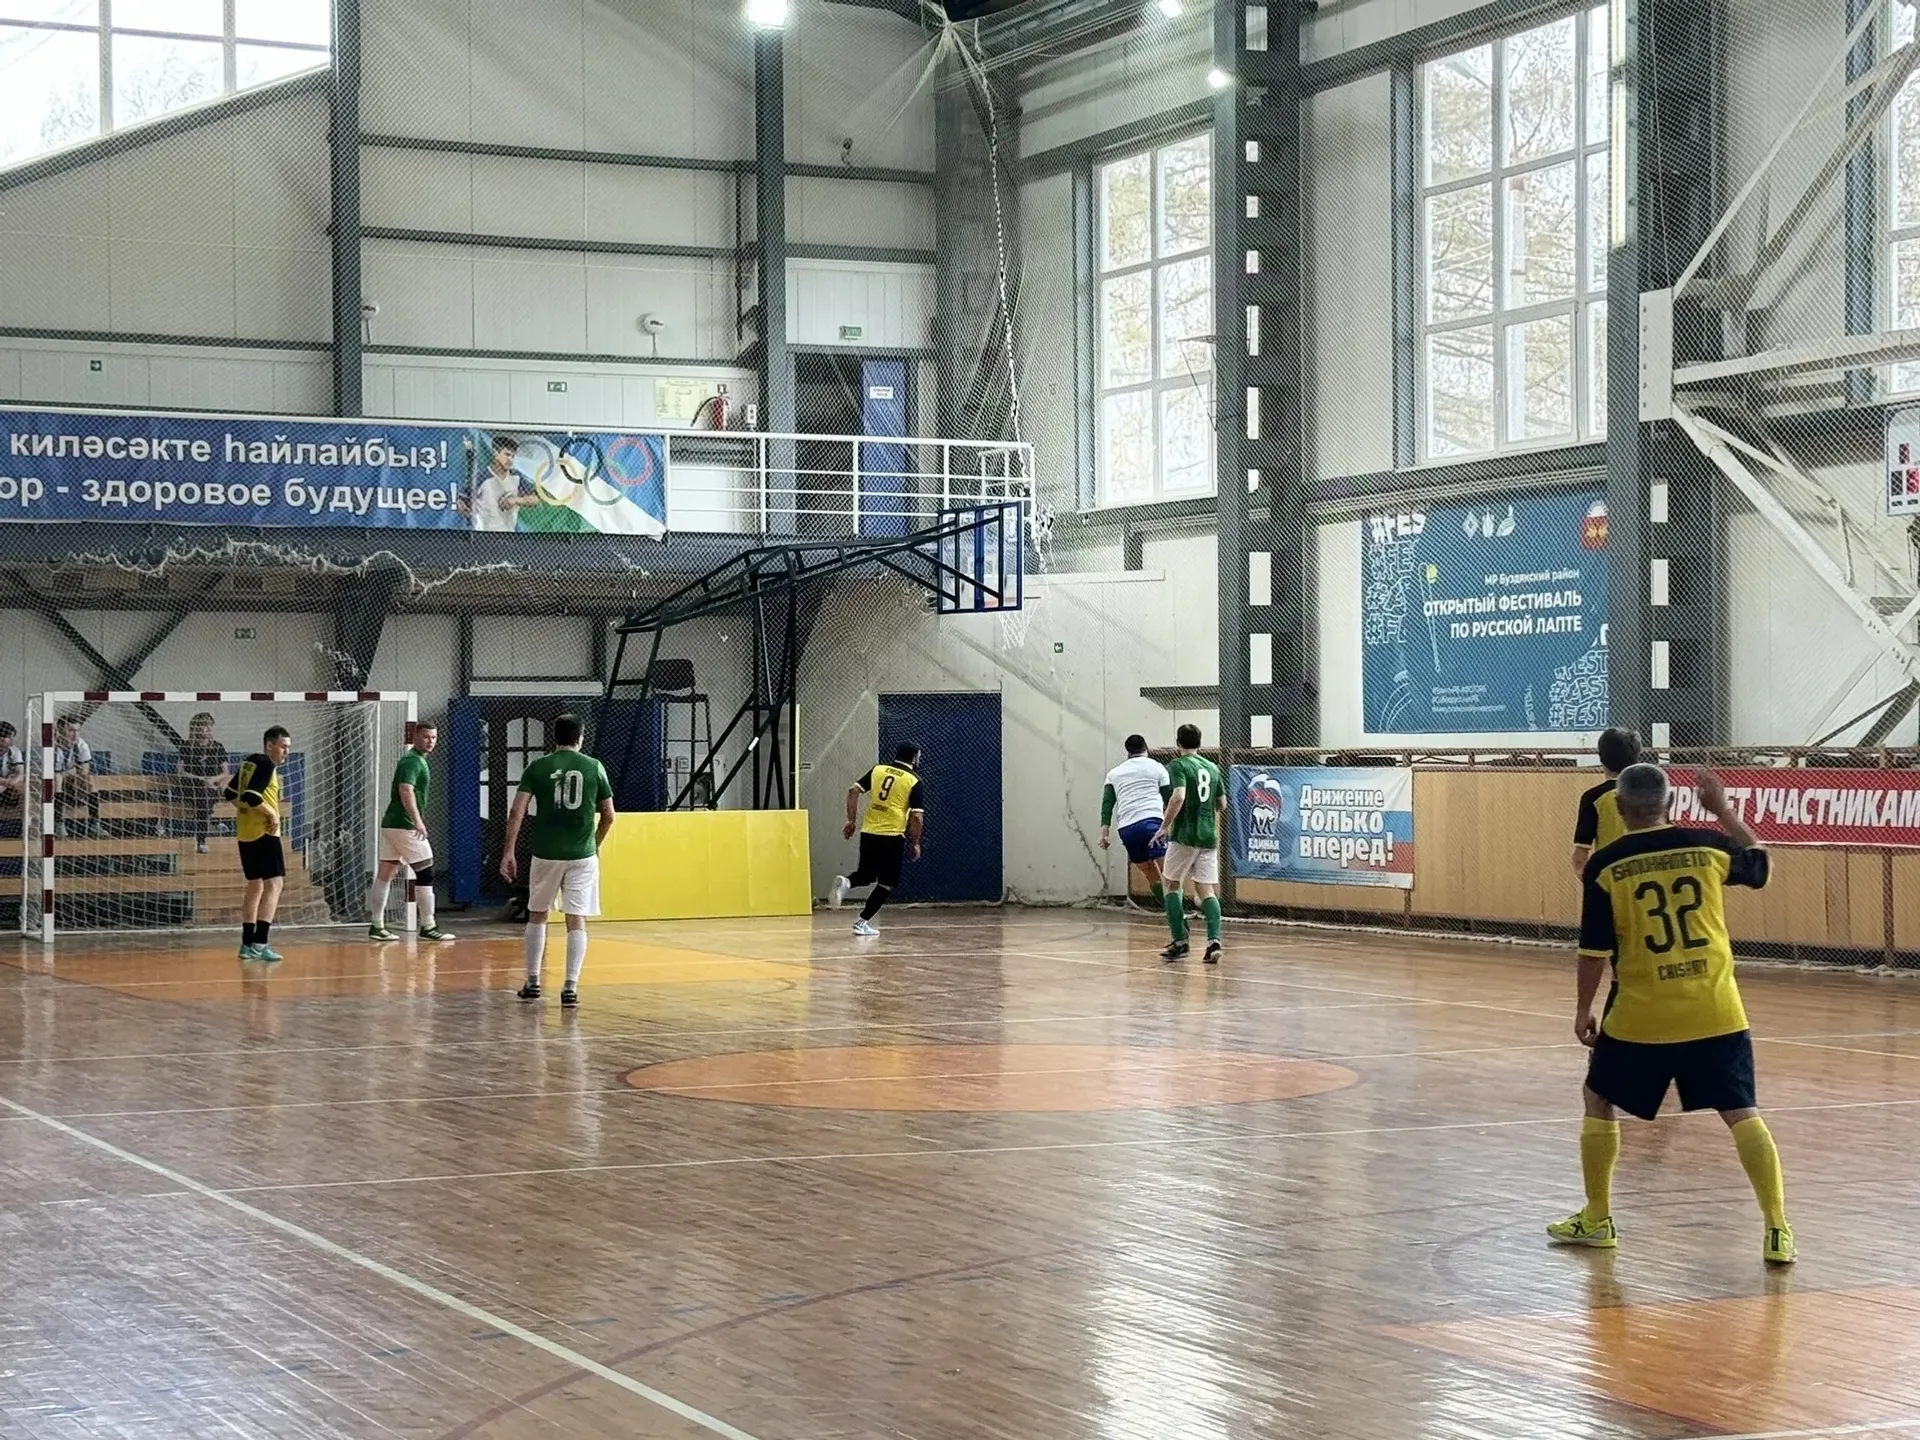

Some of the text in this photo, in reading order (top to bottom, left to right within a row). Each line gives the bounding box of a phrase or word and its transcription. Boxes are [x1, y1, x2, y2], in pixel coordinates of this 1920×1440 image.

[10, 433, 212, 462] киләсәкте
[82, 479, 272, 511] здоровое
[284, 477, 458, 515] будущее!
[1552, 567, 1580, 583] район
[1423, 590, 1582, 617] ОТКРЫТЫЙ ФЕСТИВАЛЬ
[1450, 614, 1582, 639] ПО РУССКОЙ ЛАПТЕ
[550, 769, 584, 810] 10
[878, 775, 895, 801] 9
[1197, 768, 1211, 802] 8
[1300, 784, 1384, 809] Движение
[1248, 838, 1279, 851] ЕДИНАЯ
[1248, 851, 1279, 864] РОССИЯ
[1300, 832, 1393, 867] вперед!
[1634, 875, 1710, 954] 32
